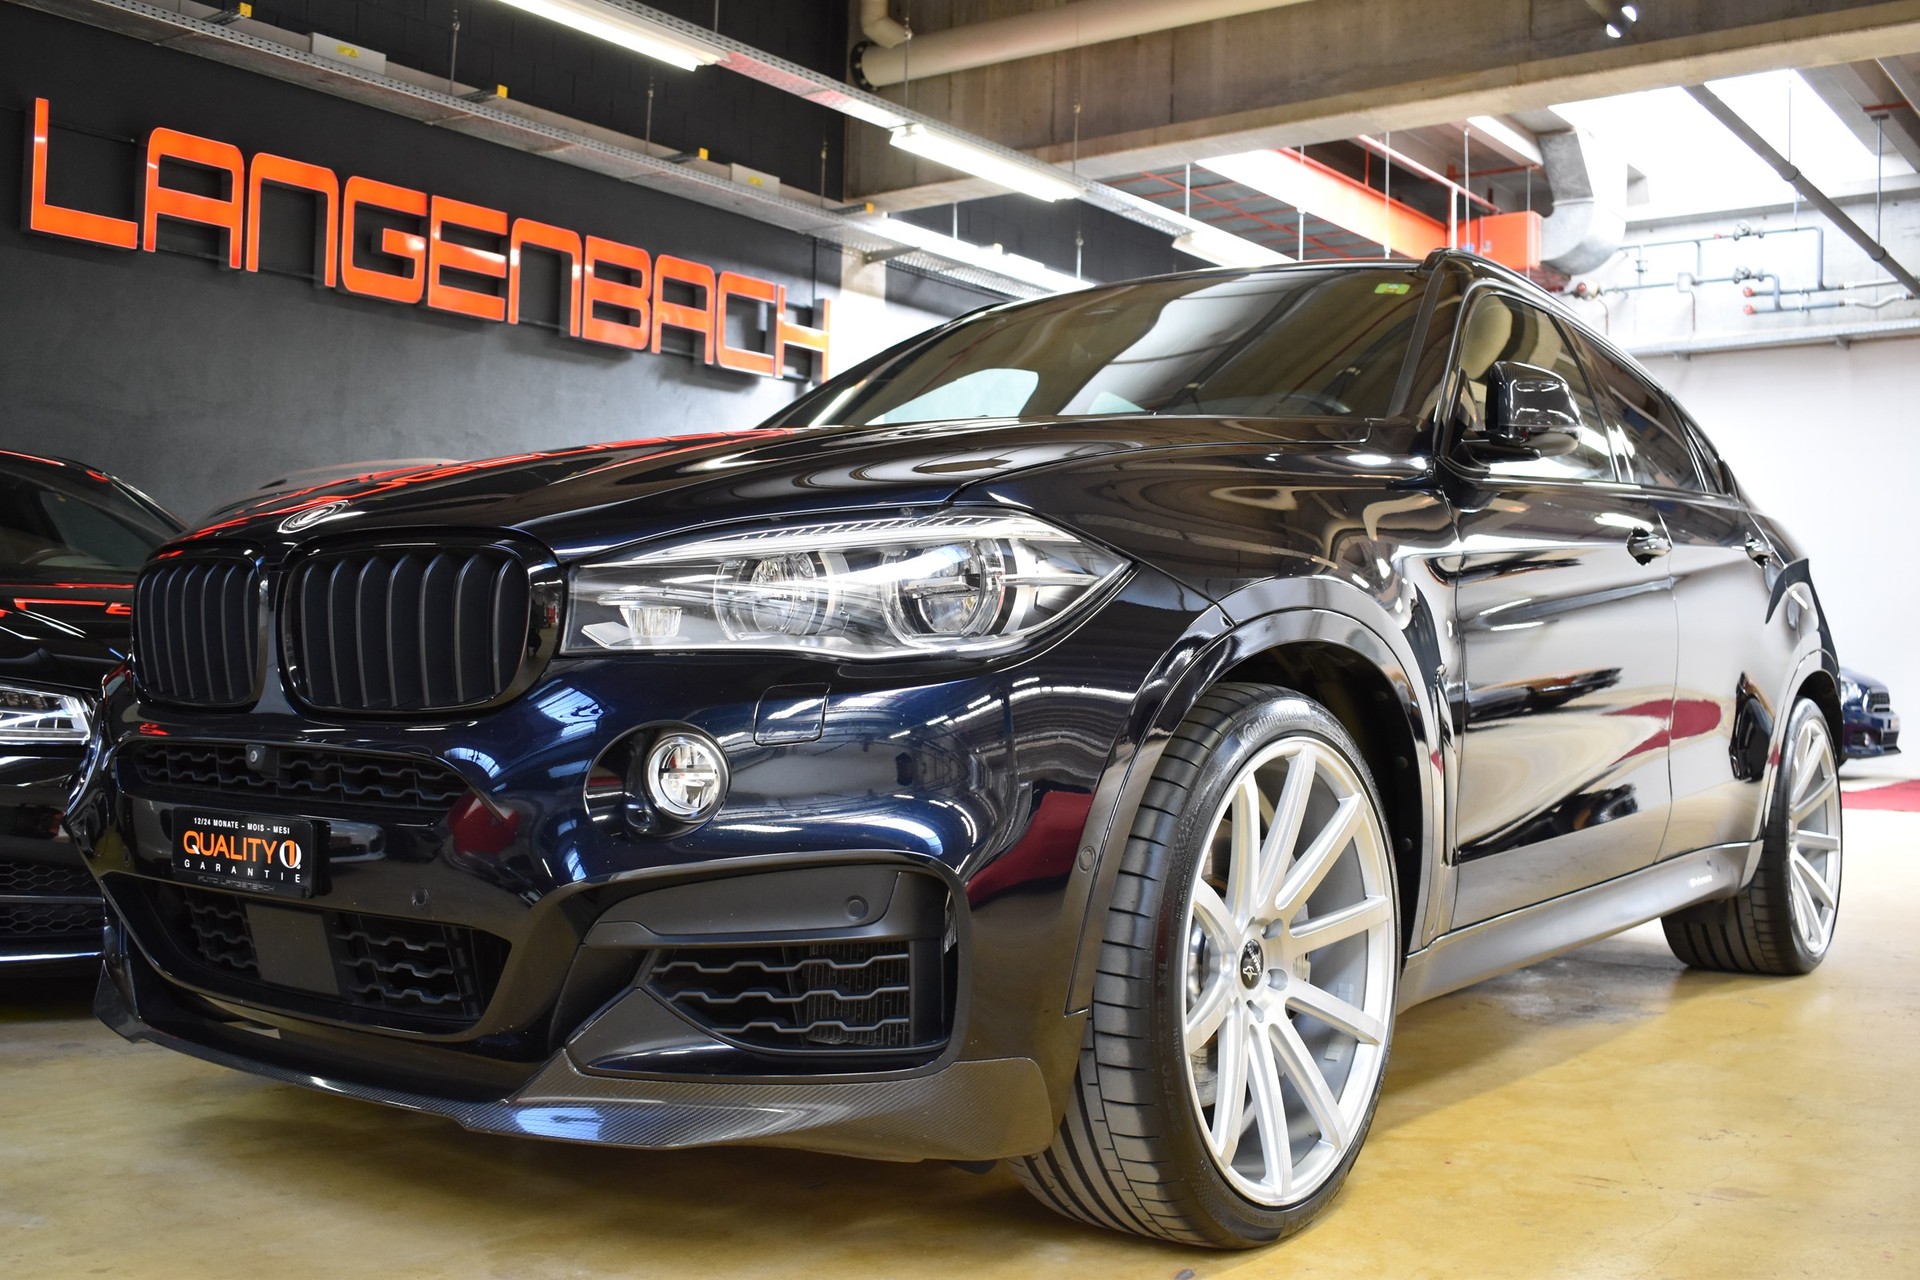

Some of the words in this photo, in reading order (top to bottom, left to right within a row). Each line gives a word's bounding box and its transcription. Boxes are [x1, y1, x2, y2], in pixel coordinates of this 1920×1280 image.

[30, 97, 831, 382] LANGENBACH
[194, 817, 211, 826] 12/24
[213, 819, 239, 829] MONATE
[247, 823, 265, 832] MOIS
[273, 826, 290, 835] MESI
[183, 830, 278, 864] QUALITY
[184, 859, 301, 883] GARANTIE
